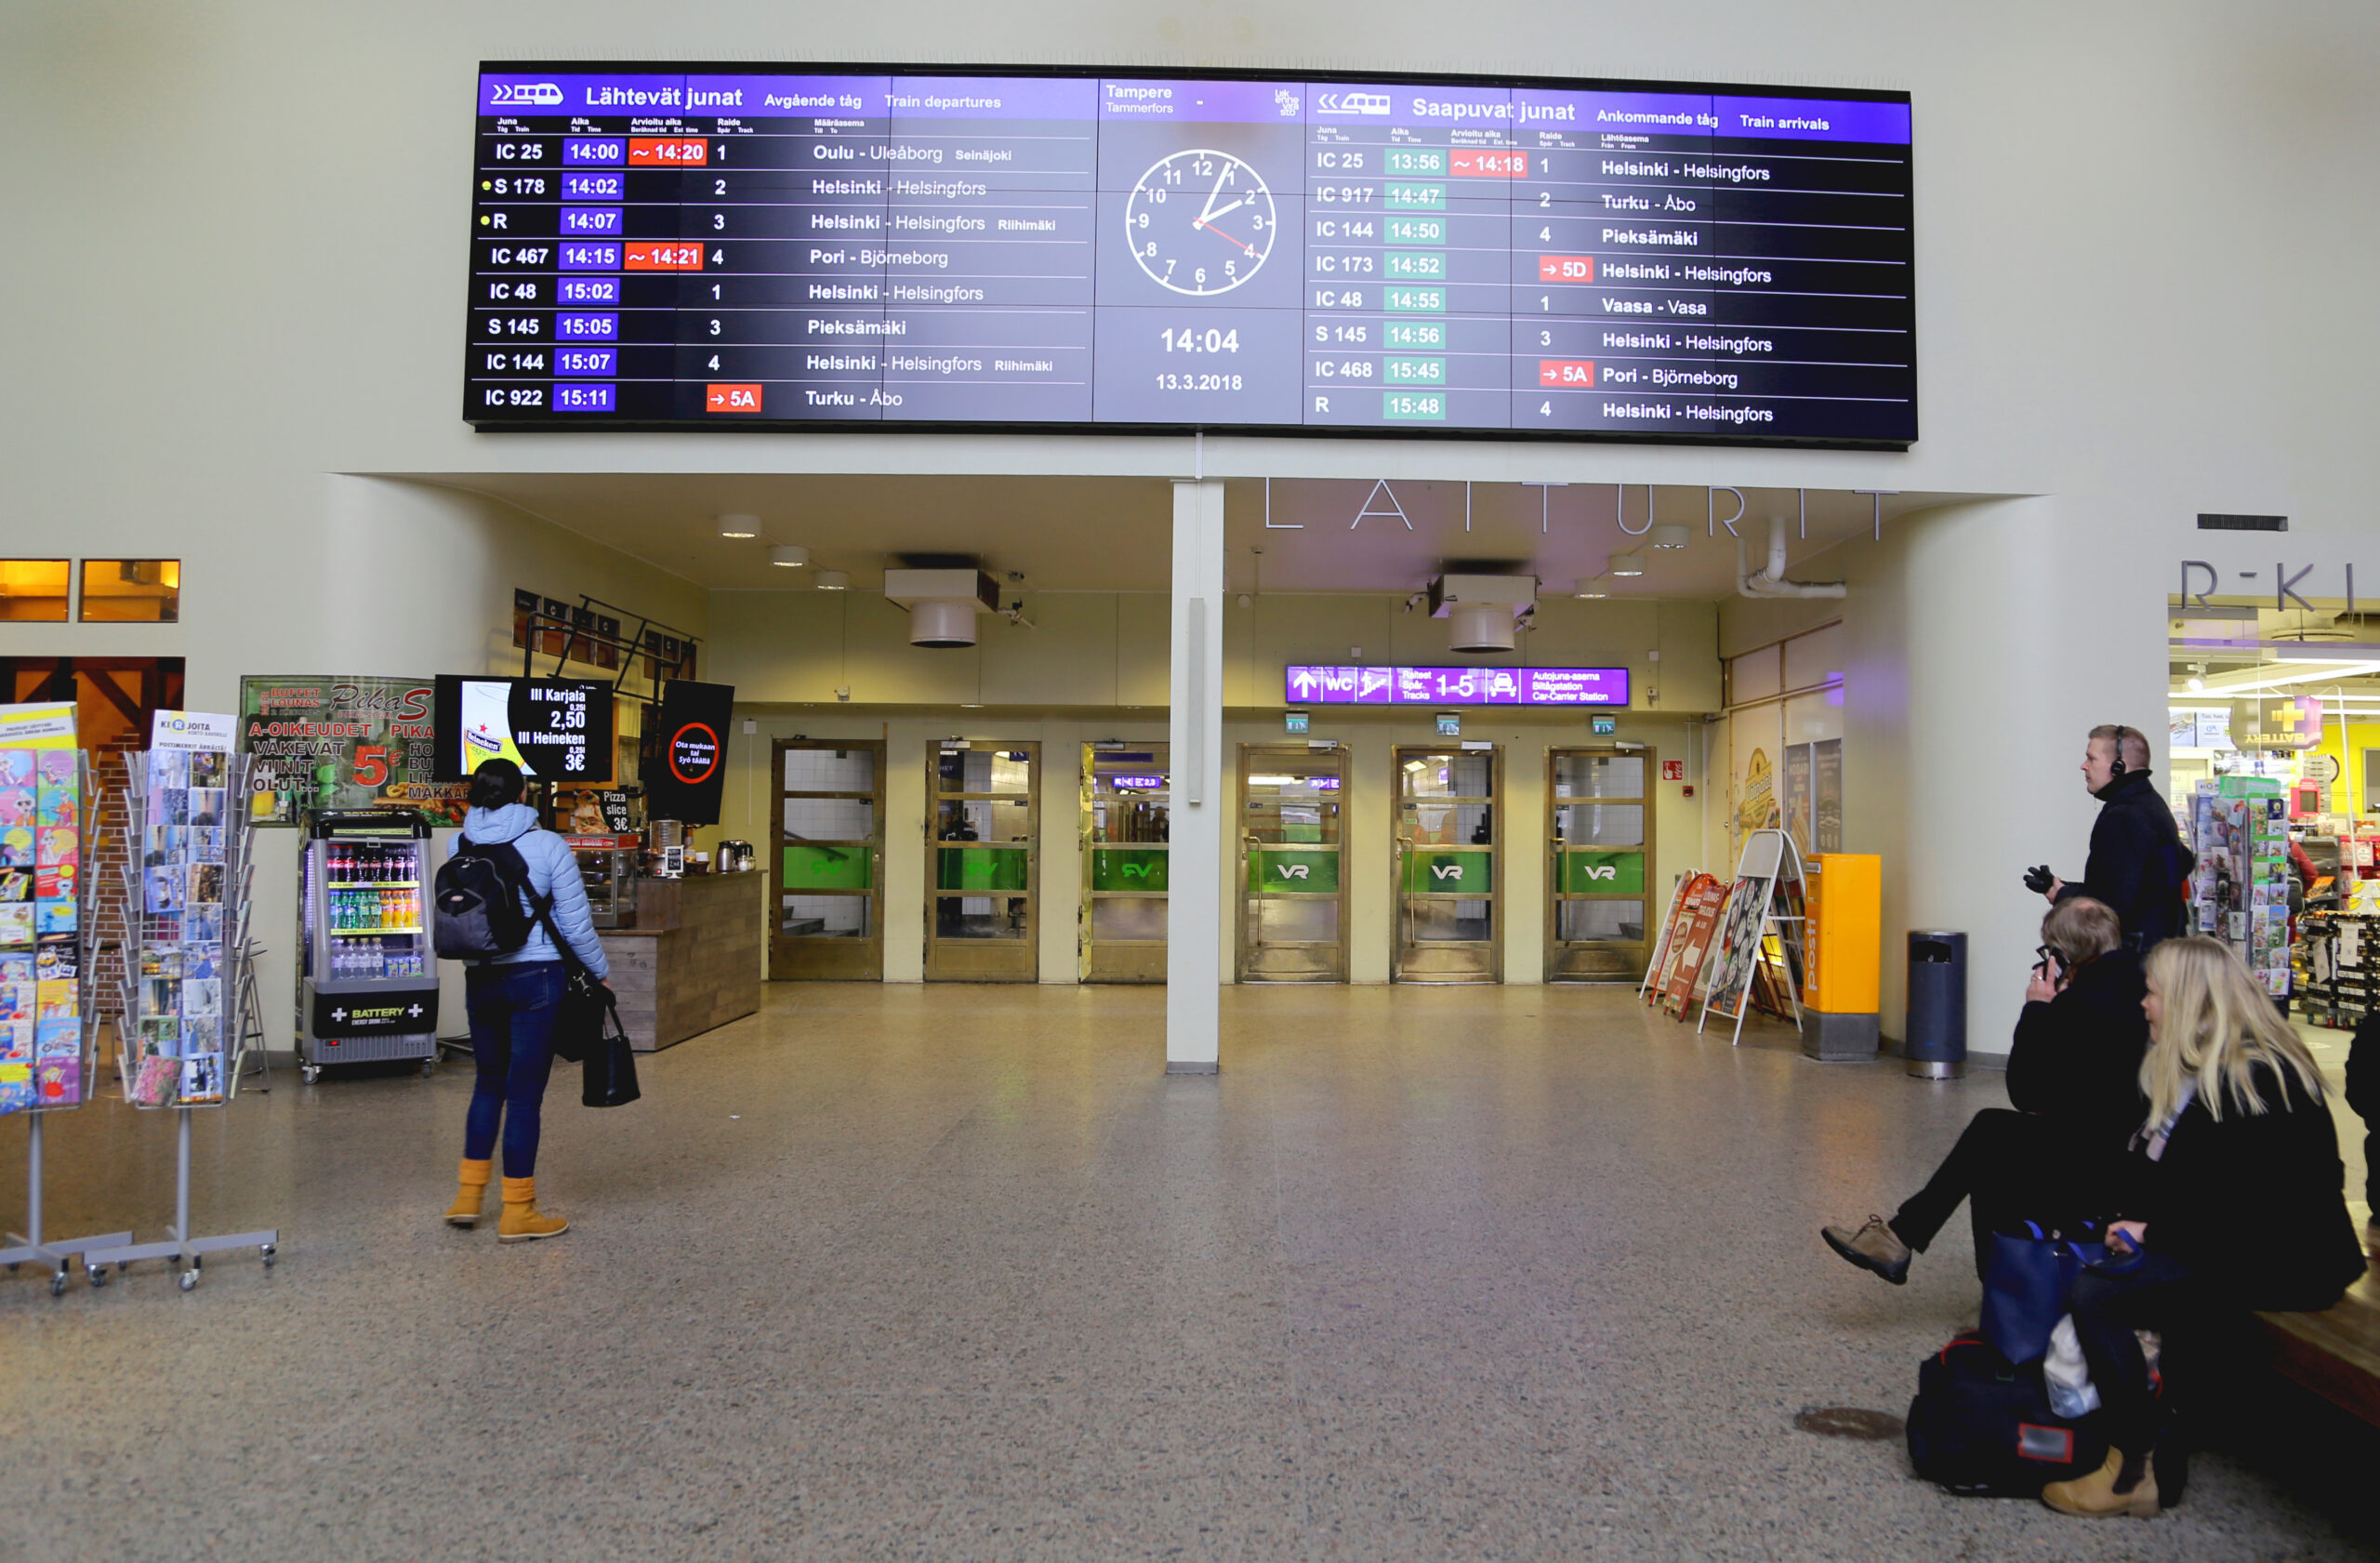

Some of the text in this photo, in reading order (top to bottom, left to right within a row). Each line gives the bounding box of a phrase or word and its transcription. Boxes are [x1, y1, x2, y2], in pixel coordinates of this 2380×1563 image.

[587, 86, 1001, 110] Lähtevät junat Avgående tåg Train departures
[1106, 84, 1172, 100] Tampere
[1106, 102, 1174, 113] Tammerfors
[1412, 98, 1830, 131] Saapuvat junat Ankommande tåg Train arrivals
[631, 118, 666, 126] Arvioitu
[718, 119, 741, 127] Raide
[814, 118, 865, 128] Määräasema
[521, 143, 1012, 164] 25 14:00 14:20 Oulu Uleåborg Seinäjoki
[1342, 152, 1770, 182] 25 13:56 14:18 Helsinki Helsingfors
[514, 179, 986, 197] 178 14:02 Helsinki Helsingfors
[1342, 187, 1696, 211] 917 14:47 Turku Åbo
[568, 213, 1056, 232] 14:07 Helsinki Helsingfors Riihimäki
[1343, 221, 1698, 245] 144 14:50 Pieksämäki
[516, 247, 948, 268] 467 14:15 14:21 Pori Björneborg
[1342, 256, 1771, 285] 173 14:52 5D Helsinki Helsingfors
[514, 283, 984, 303] 48 15:02 Helsinki Helsingfors
[1341, 290, 1707, 315] 48 14:55 Vaasa Vasa
[509, 318, 906, 335] 145 15:05 Pieksämäki
[1161, 326, 1239, 352] 14:04
[1335, 325, 1773, 355] 145 14:56 Helsinki Helsingfors
[512, 353, 1053, 374] 144 15:07 Helsinki Helsingfors Riihimäki
[1156, 373, 1243, 391] 13.3.2018
[1341, 361, 1738, 389] 468 15:45 5A Pori Björneborg
[510, 388, 903, 406] 922 15:11 5A Turku Åbo
[1391, 397, 1774, 424] 15:48 Helsinki Helsingfors
[1265, 477, 1900, 541] LAITURIT
[1403, 671, 1432, 681] Raiteet
[1532, 671, 1600, 682] Autojuna-asema
[271, 687, 320, 697] BUFFET
[1326, 677, 1353, 692] WC
[1403, 681, 1422, 692] Spår
[1436, 674, 1474, 697] 1-5
[1532, 682, 1582, 693] Biltågstation
[271, 698, 320, 708] LOUNAS
[546, 688, 586, 704] Karjala
[1403, 691, 1430, 700] Tracks
[1532, 691, 1608, 702] Car-Carrier Station
[550, 710, 585, 730] 2,50
[248, 722, 372, 737] A-OIKEUDET
[390, 724, 434, 738] PIKA
[468, 731, 499, 751] Heineken
[534, 732, 585, 745] Heineken
[676, 741, 688, 749] Ota
[2245, 733, 2306, 744] BATTERY
[254, 739, 346, 756] VÄKEVÄT
[256, 760, 314, 774] VIINIT
[351, 745, 388, 787] 5
[409, 758, 434, 771] BU
[565, 754, 585, 771] 3€
[679, 756, 692, 765] Syö
[253, 778, 320, 792] OLUT...
[604, 791, 626, 801] Pizza
[606, 804, 627, 815] slice
[614, 817, 628, 831] 3€
[1277, 864, 1310, 880] VR
[1432, 865, 1463, 881] VR
[1584, 865, 1616, 881] VR
[352, 1007, 405, 1019] BATTERY
